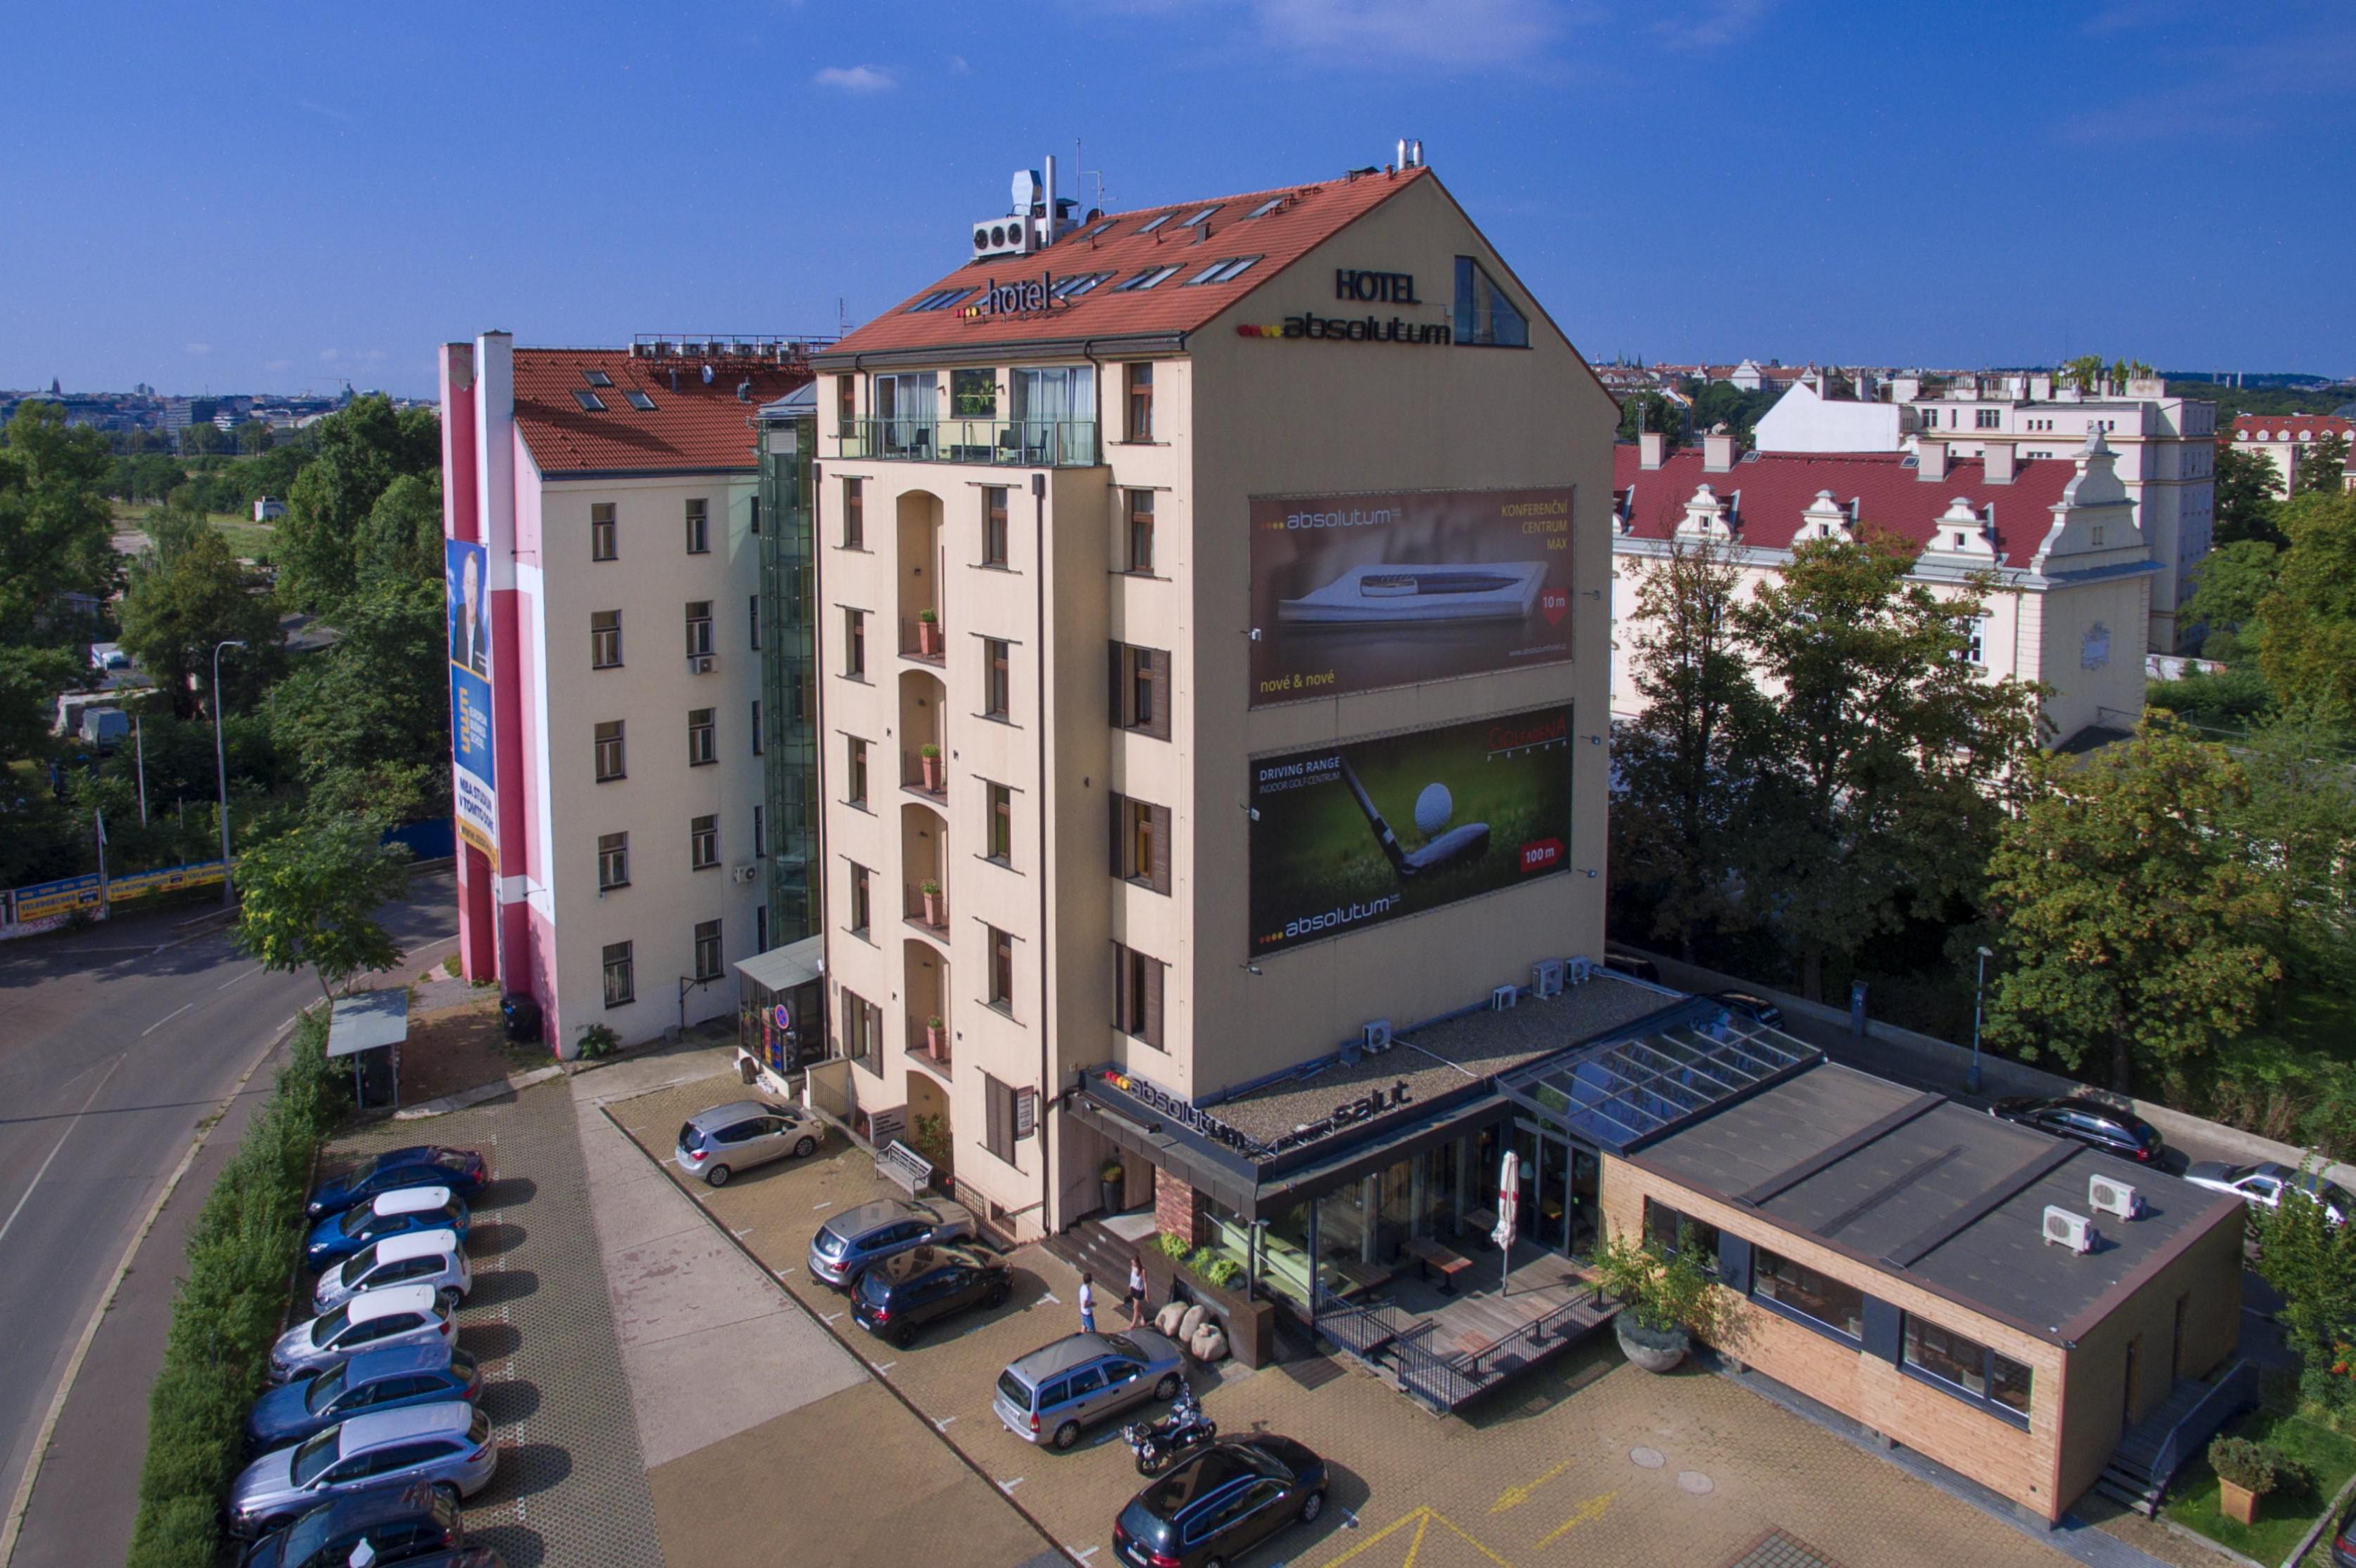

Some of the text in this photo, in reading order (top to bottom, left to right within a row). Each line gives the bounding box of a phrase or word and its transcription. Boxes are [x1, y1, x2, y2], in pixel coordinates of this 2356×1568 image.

[988, 271, 1050, 314] hotel
[1336, 269, 1422, 304] HOTEL
[1284, 312, 1451, 345] absolutum
[1287, 509, 1391, 529] absolutum
[1501, 500, 1567, 517] KONFERENČNÍ
[1522, 519, 1567, 533] CENTRUM
[1547, 538, 1567, 550] MAX
[1543, 596, 1565, 609] 10 m
[1260, 669, 1335, 693] nové & nové
[1260, 757, 1340, 781] DRIVING RANGE
[1526, 847, 1555, 863] 100 m
[1286, 898, 1390, 937] absolutum
[1130, 1078, 1246, 1149] absolutum
[1333, 1079, 1413, 1126] salut
